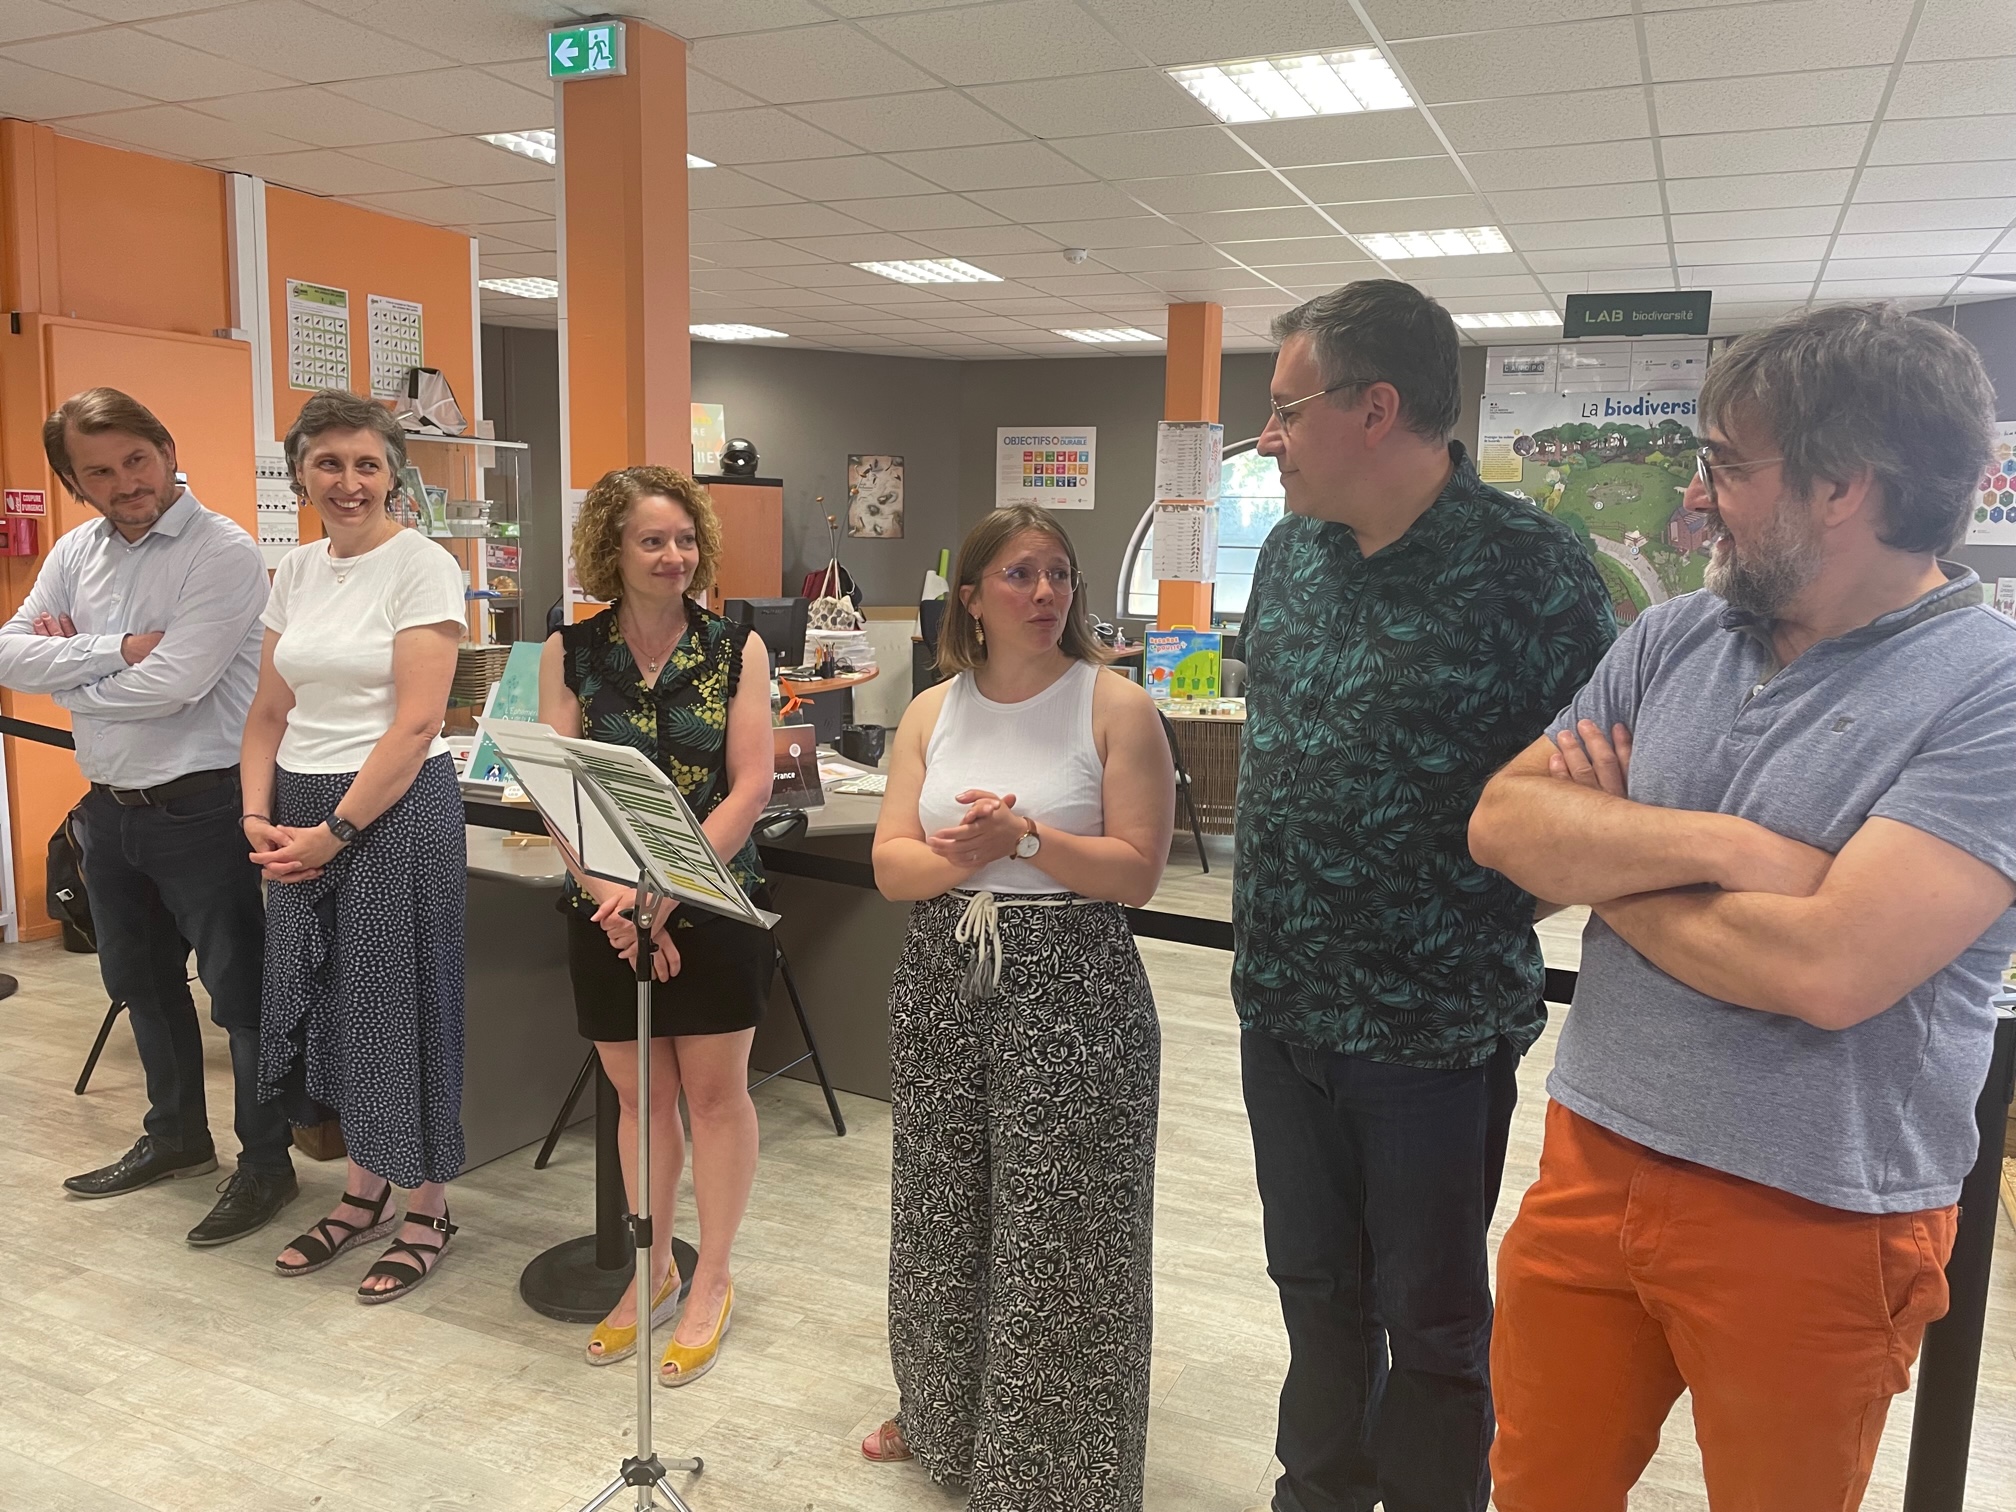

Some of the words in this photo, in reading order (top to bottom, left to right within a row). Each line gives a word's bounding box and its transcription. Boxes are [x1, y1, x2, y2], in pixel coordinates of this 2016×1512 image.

[1585, 310, 1623, 323] LAB
[1632, 310, 1694, 321] biodiversité
[1581, 402, 1599, 418] La
[1604, 396, 1698, 417] biodiversi
[1003, 435, 1051, 446] OBJECTIFS
[774, 771, 796, 781] France
